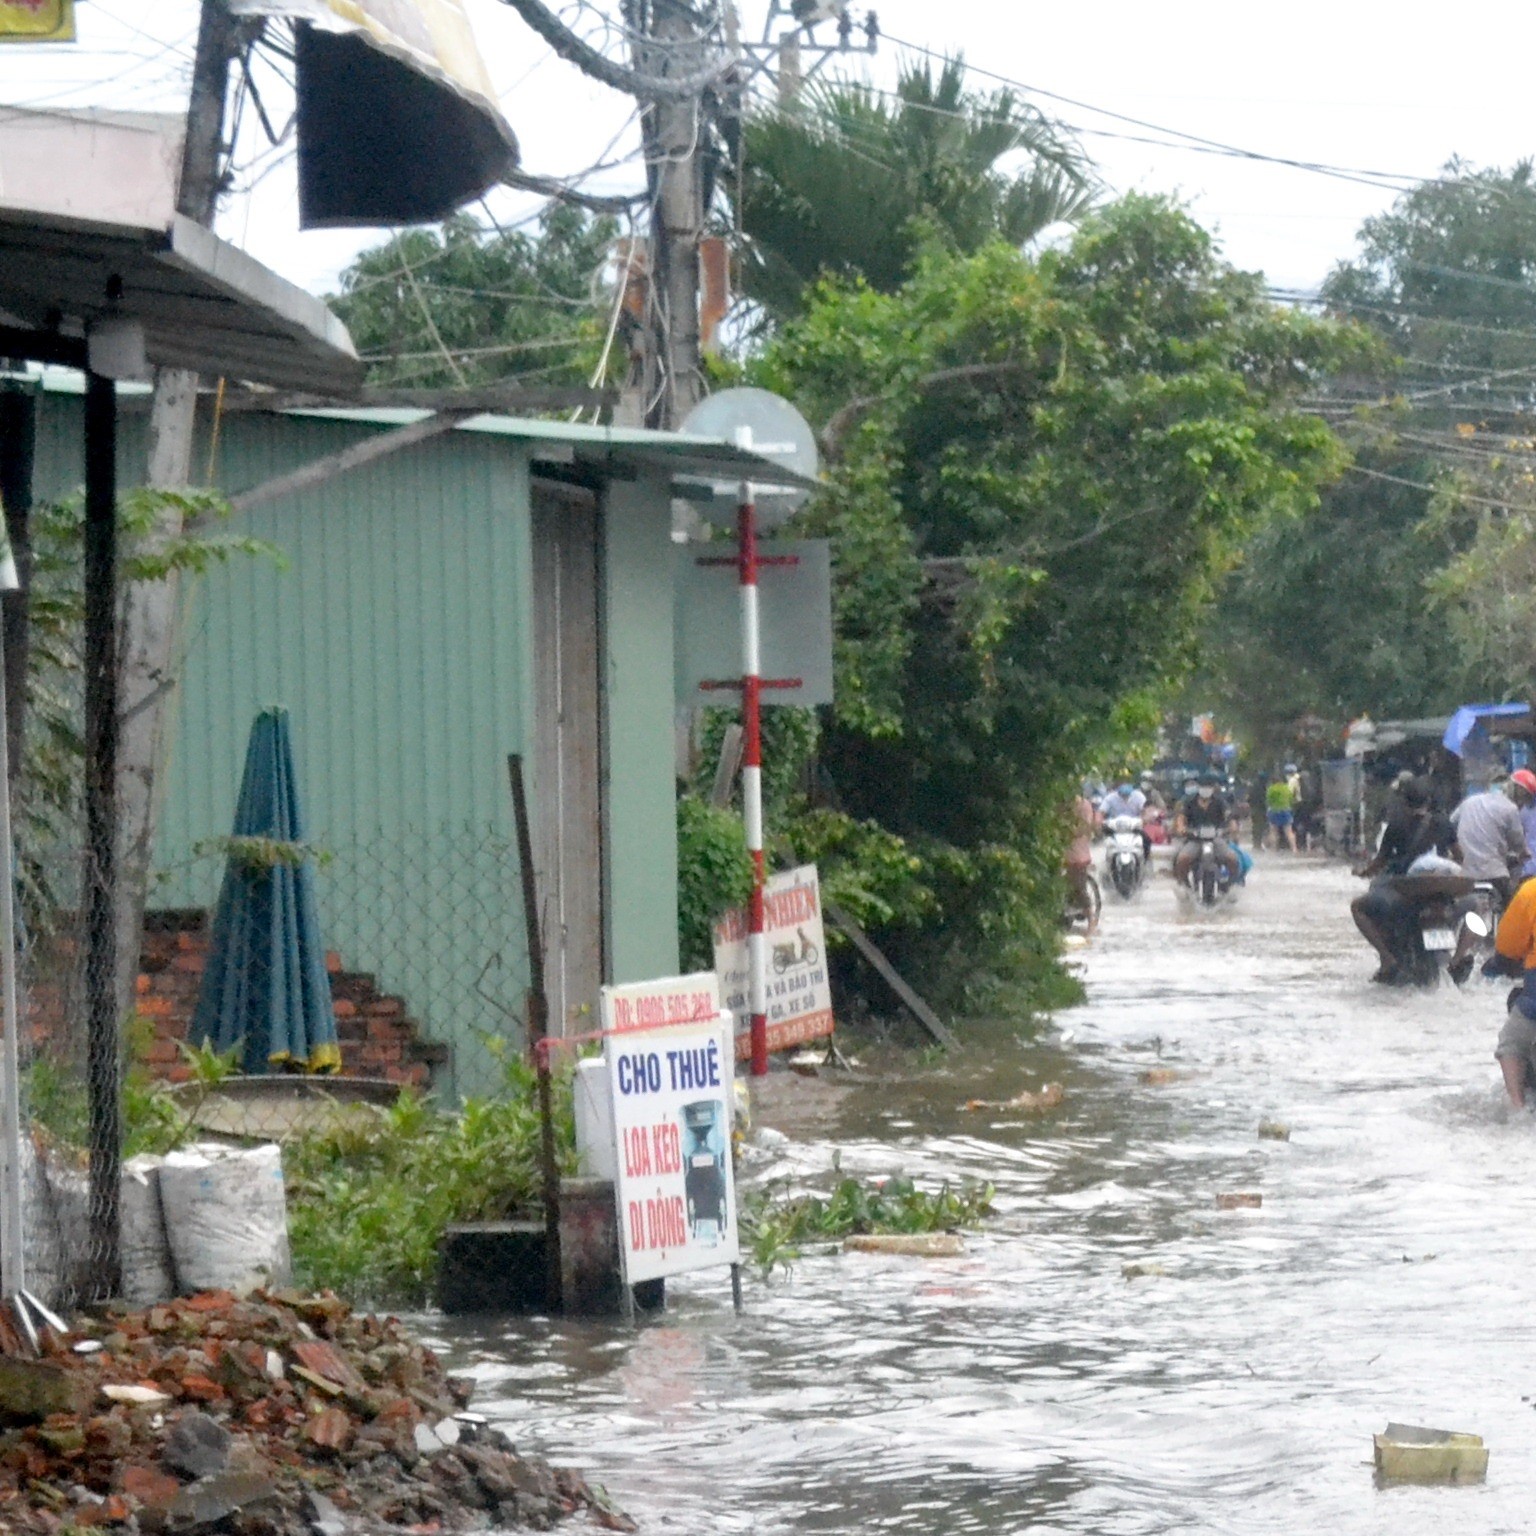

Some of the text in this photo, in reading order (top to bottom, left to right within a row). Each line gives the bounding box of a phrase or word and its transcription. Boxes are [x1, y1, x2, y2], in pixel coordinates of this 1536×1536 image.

[617, 1053, 662, 1096] CHO
[666, 1038, 721, 1091] THUÊ
[622, 1112, 681, 1178] LOA KÉO
[628, 1199, 646, 1251] DI
